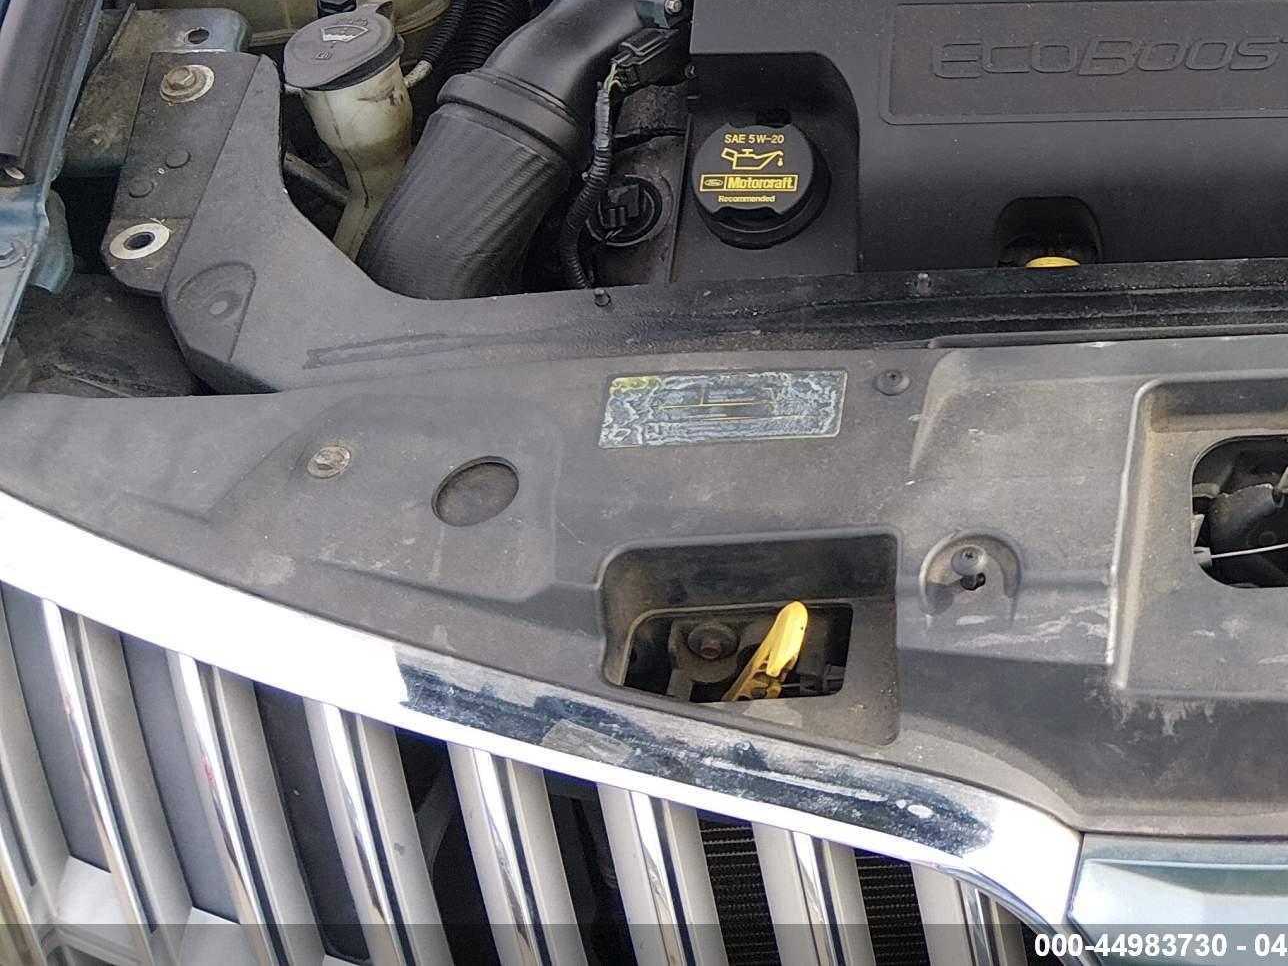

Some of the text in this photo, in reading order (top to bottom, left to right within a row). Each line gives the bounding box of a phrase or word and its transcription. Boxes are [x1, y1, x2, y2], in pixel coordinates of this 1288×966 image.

[724, 134, 785, 144] SAE 5W-20
[727, 176, 793, 189] Motorcraft
[718, 195, 776, 203] Recommended
